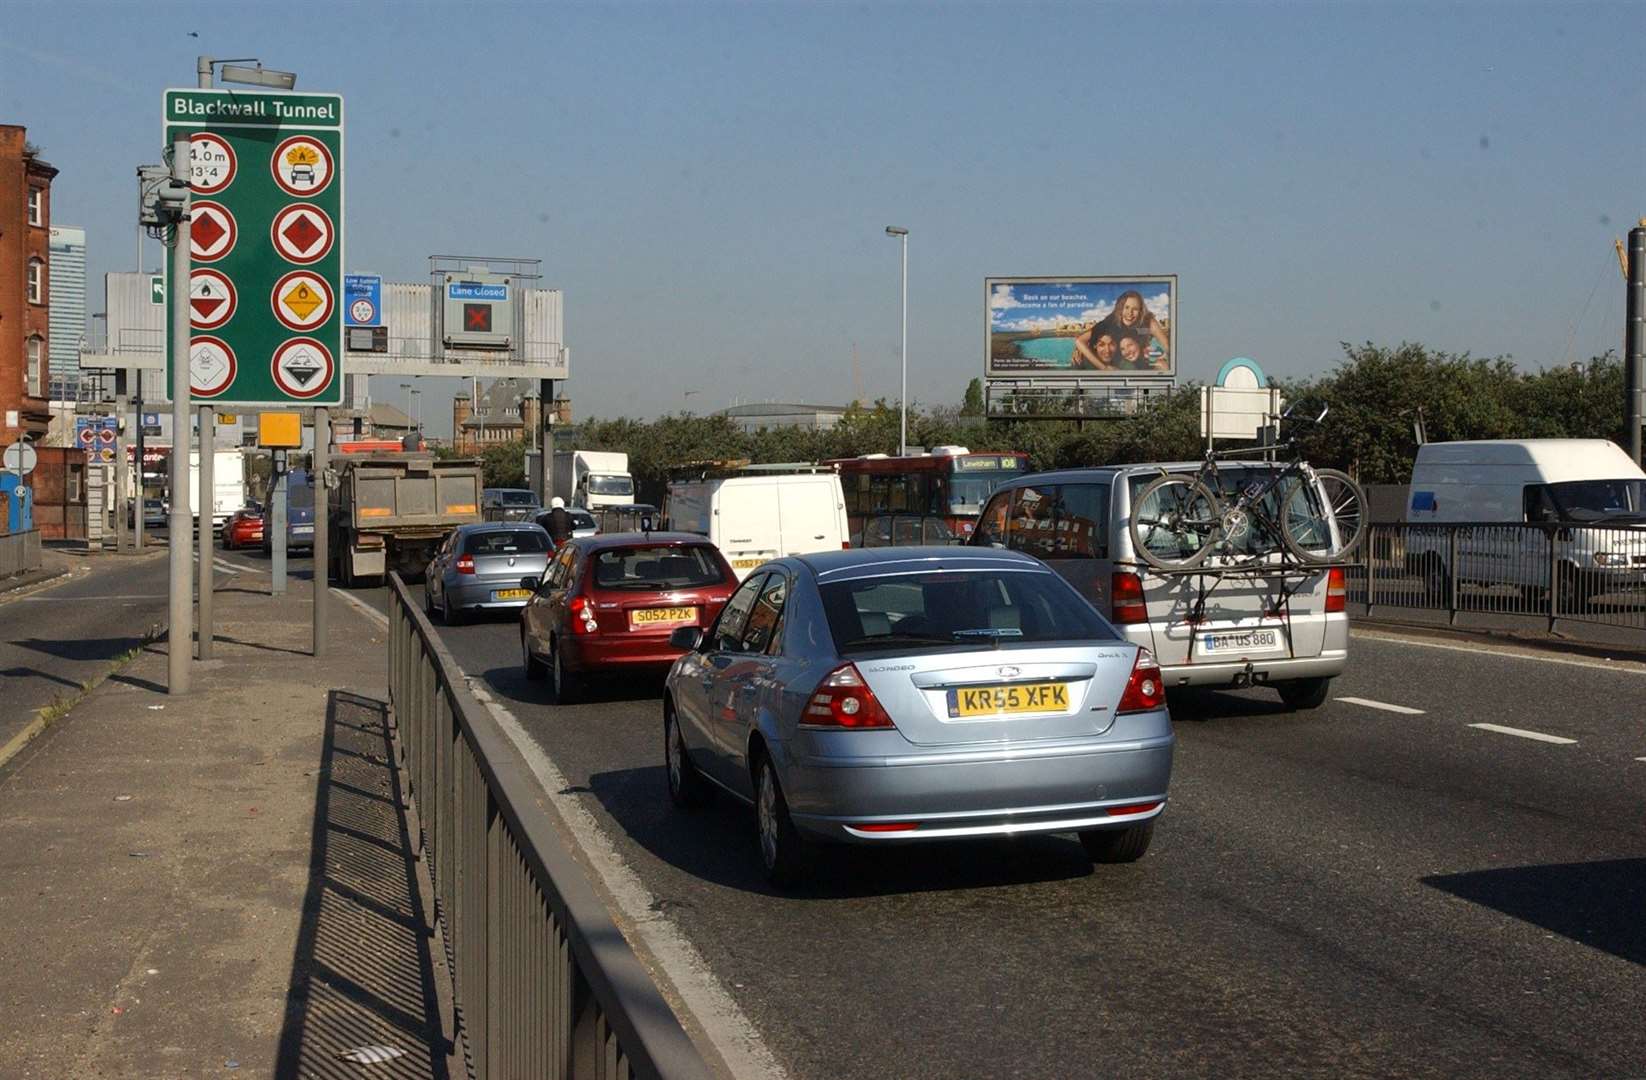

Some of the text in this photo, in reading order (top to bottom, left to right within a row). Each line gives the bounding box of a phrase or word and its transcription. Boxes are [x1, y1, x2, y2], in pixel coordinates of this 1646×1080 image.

[174, 98, 335, 118] Blackwall Tunnel
[451, 286, 505, 297] Lane Closed
[669, 609, 692, 619] PZK
[1252, 632, 1275, 646] 880
[964, 684, 1067, 711] KR55 XFK
